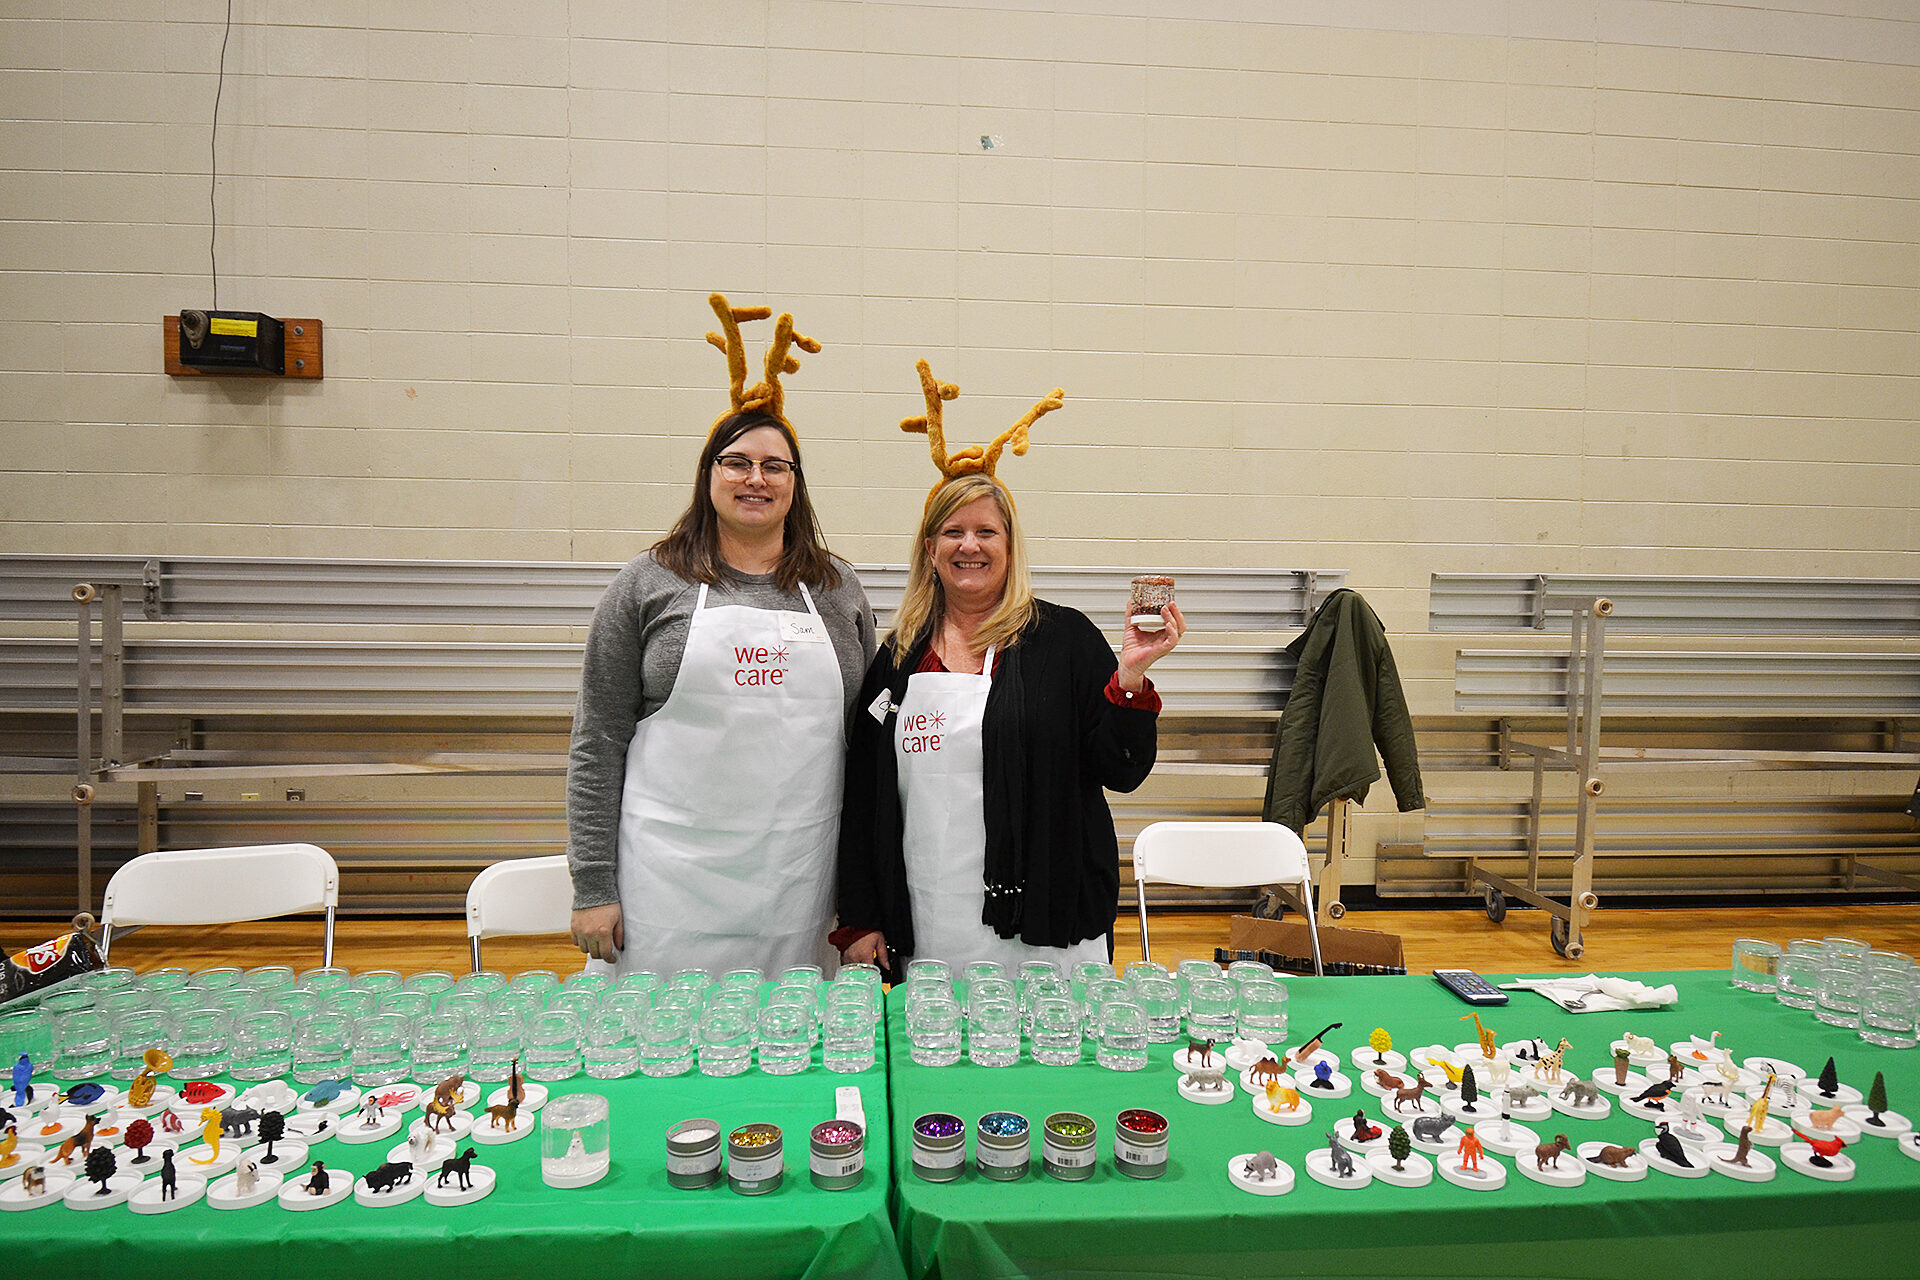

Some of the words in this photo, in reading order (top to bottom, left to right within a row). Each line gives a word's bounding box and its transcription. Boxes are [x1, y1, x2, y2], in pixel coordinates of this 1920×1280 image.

[790, 622, 815, 635] Sam
[734, 647, 769, 664] we
[903, 714, 927, 732] we
